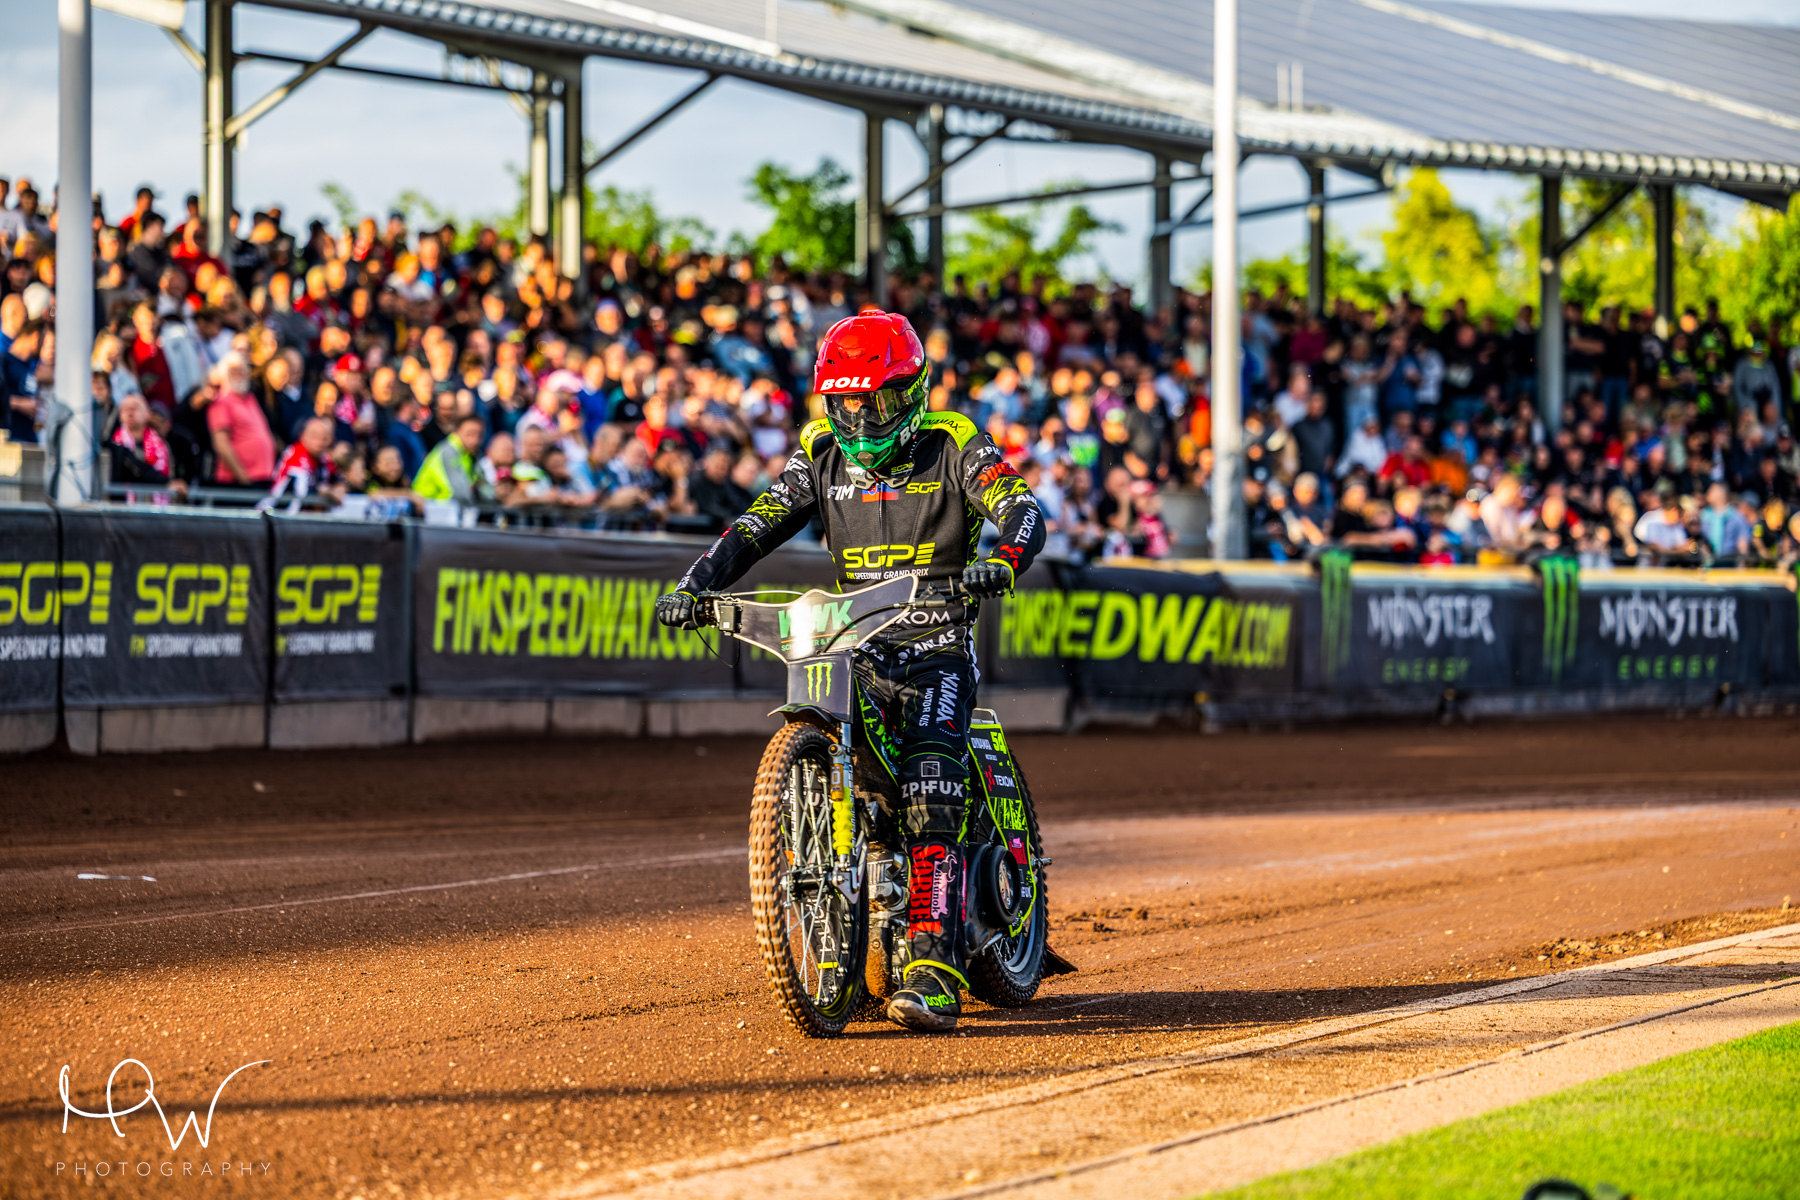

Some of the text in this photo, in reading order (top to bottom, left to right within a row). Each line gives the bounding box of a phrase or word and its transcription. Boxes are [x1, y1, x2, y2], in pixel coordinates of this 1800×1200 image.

[820, 377, 871, 391] BOLL
[827, 484, 855, 500] FIM
[905, 481, 941, 494] SGP
[1014, 507, 1039, 544] TEXOM
[854, 572, 882, 580] SPEEDWAY
[1000, 588, 1292, 667] FIMSPEDWAY.COM
[1367, 588, 1495, 648] MONSTER
[1600, 588, 1739, 648] MONSTER
[827, 634, 858, 646] PRTNER
[914, 629, 957, 656] ANLAS
[1382, 657, 1470, 684] ENERGY
[1617, 655, 1719, 681] ENERGY
[922, 687, 935, 713] MOTOR
[990, 731, 1008, 755] 54
[993, 774, 1016, 788] TEXOM
